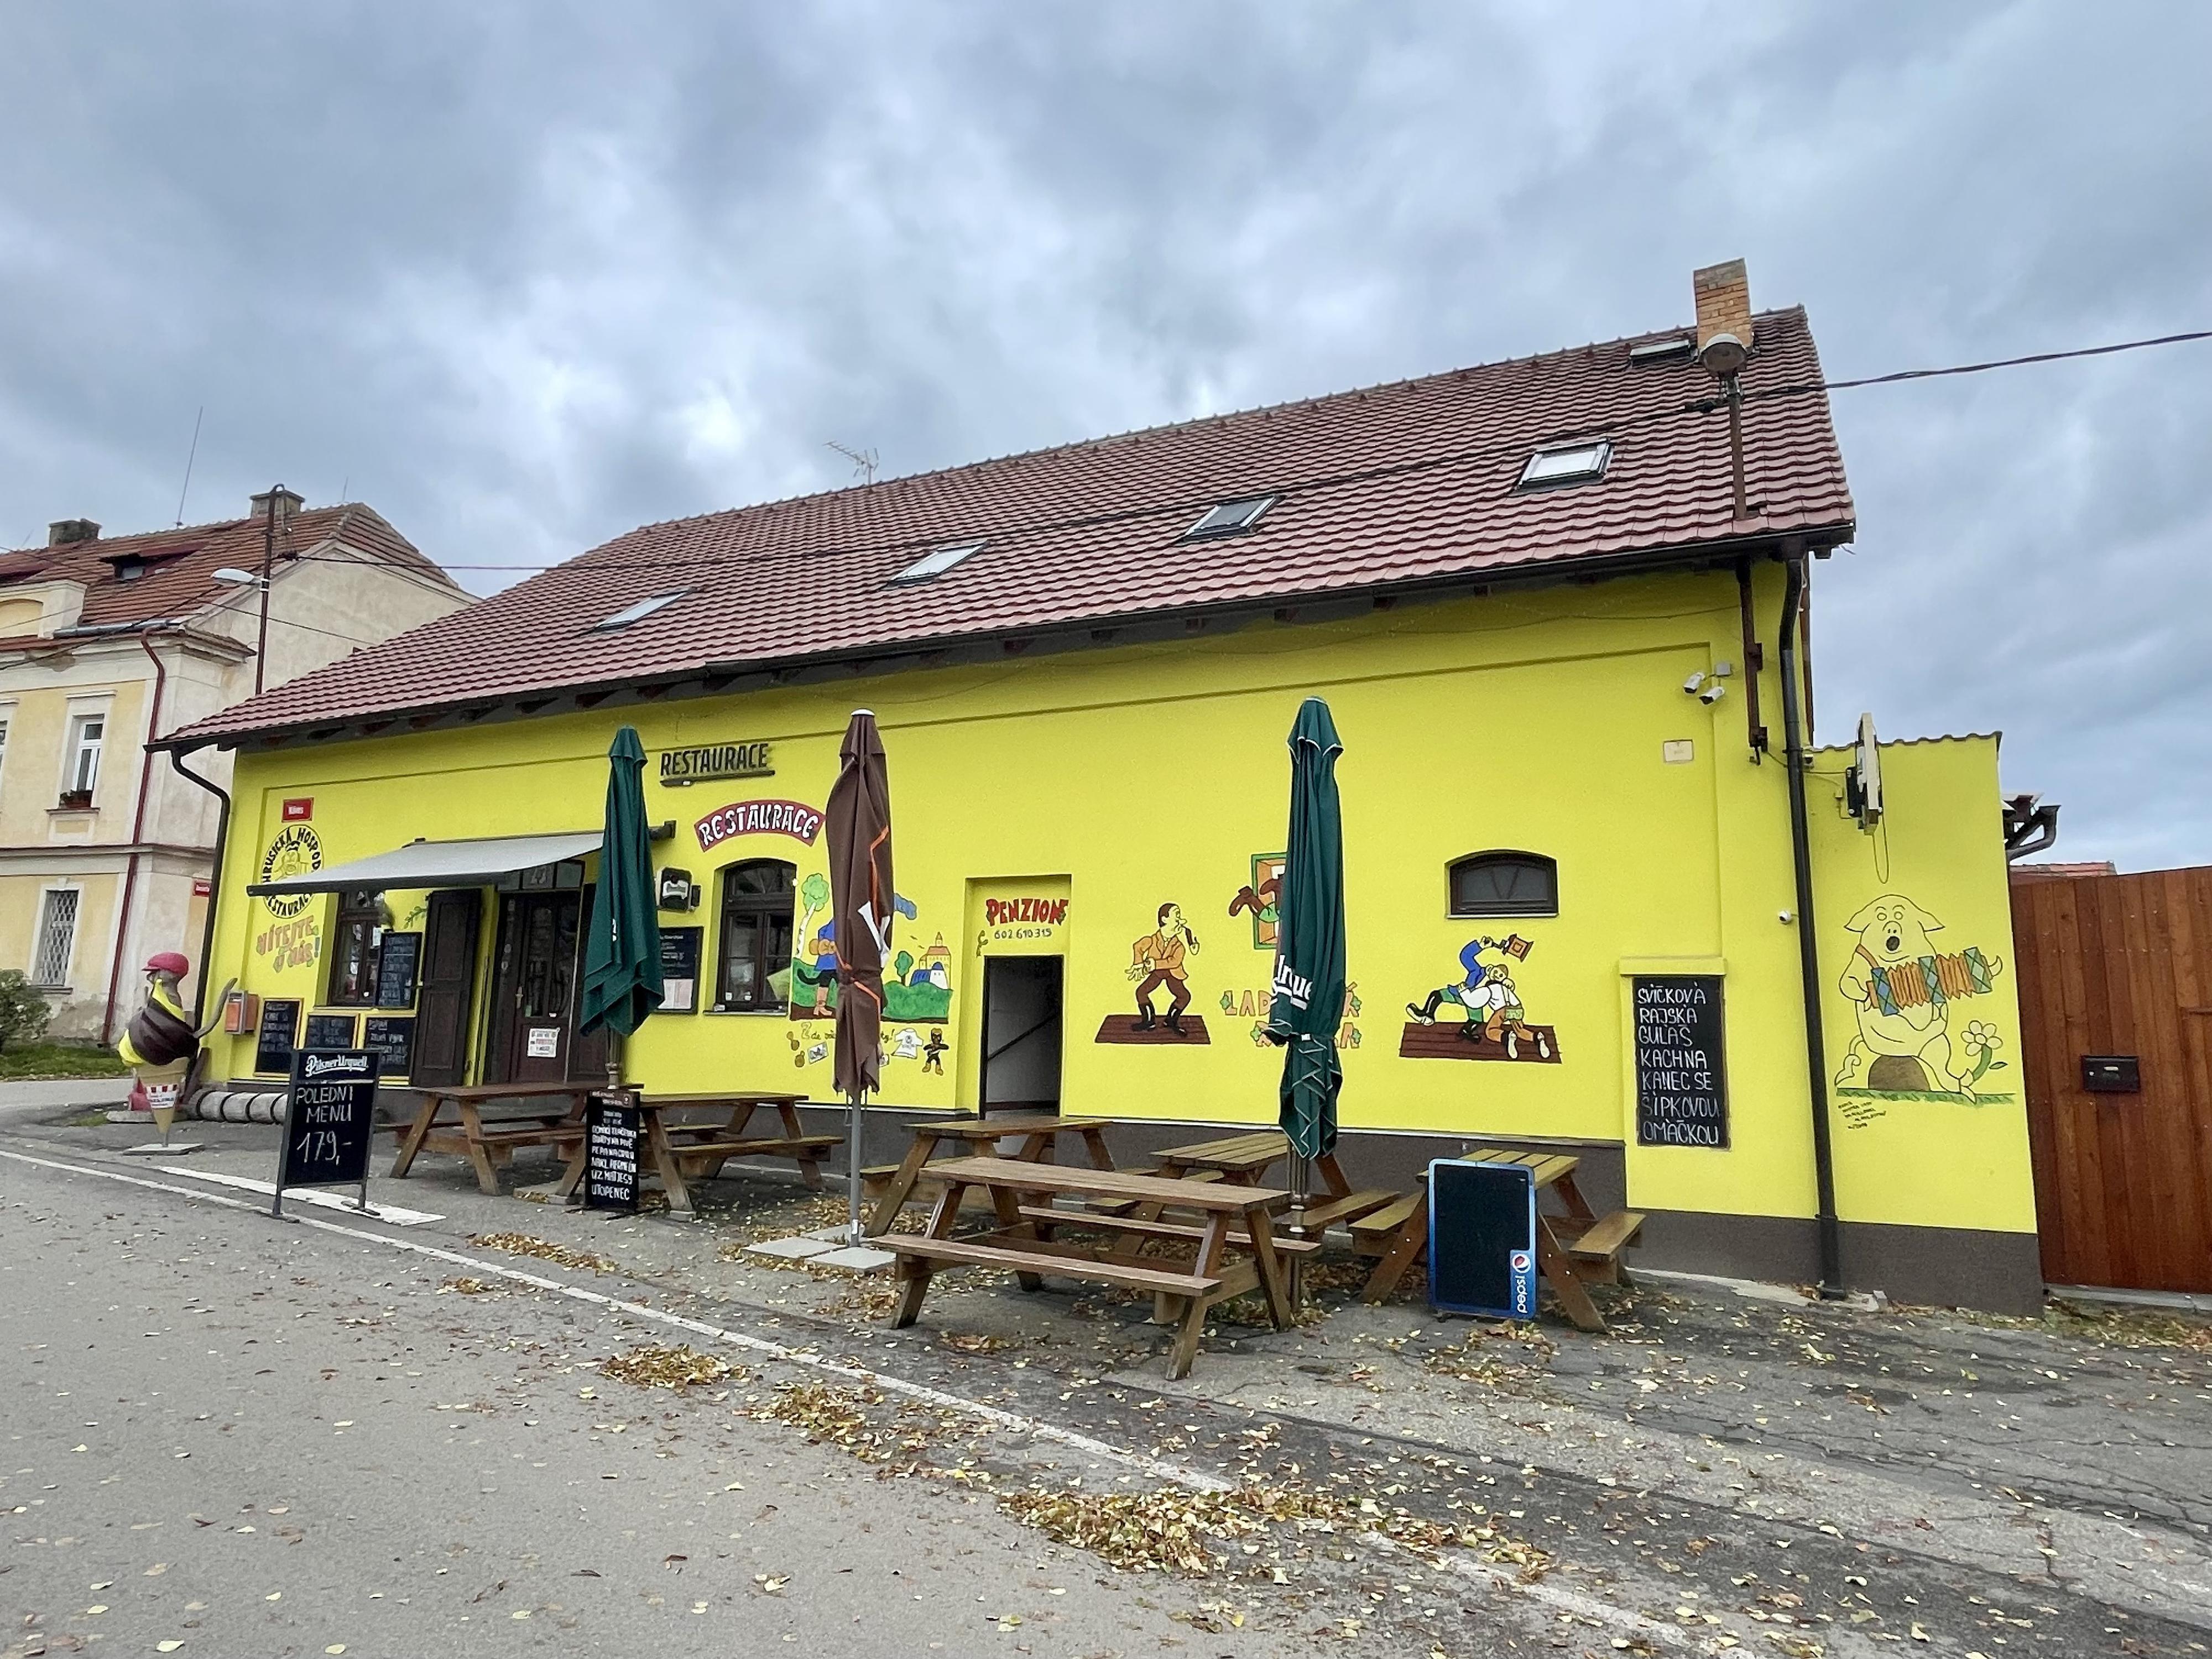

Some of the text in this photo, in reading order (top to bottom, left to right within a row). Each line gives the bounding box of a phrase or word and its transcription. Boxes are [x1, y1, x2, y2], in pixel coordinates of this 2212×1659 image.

[660, 743, 769, 776] RESTAURACE
[698, 804, 819, 847] RESTAURACE
[296, 827, 322, 873] HOSPOD
[264, 892, 314, 916] ESTAURAC
[986, 898, 1069, 927] PENZION
[256, 915, 314, 956] VÍTEJTE
[994, 929, 1013, 939] 602
[1637, 982, 1706, 1005] SVÍČKOVÁ
[1640, 1004, 1698, 1024] RAJSKÁ
[1638, 1024, 1693, 1046] GULÁŠ
[1640, 1048, 1707, 1069] KACHNA
[1694, 1071, 1713, 1091] SE
[306, 1103, 352, 1123] MENU
[1642, 1091, 1719, 1118] ŠÍPKOVOU
[1643, 1118, 1719, 1145] OMÁČKOU
[296, 1130, 353, 1166] 179,-
[592, 1183, 630, 1201] UTOPENEC
[1515, 1275, 1527, 1313] pepsi
